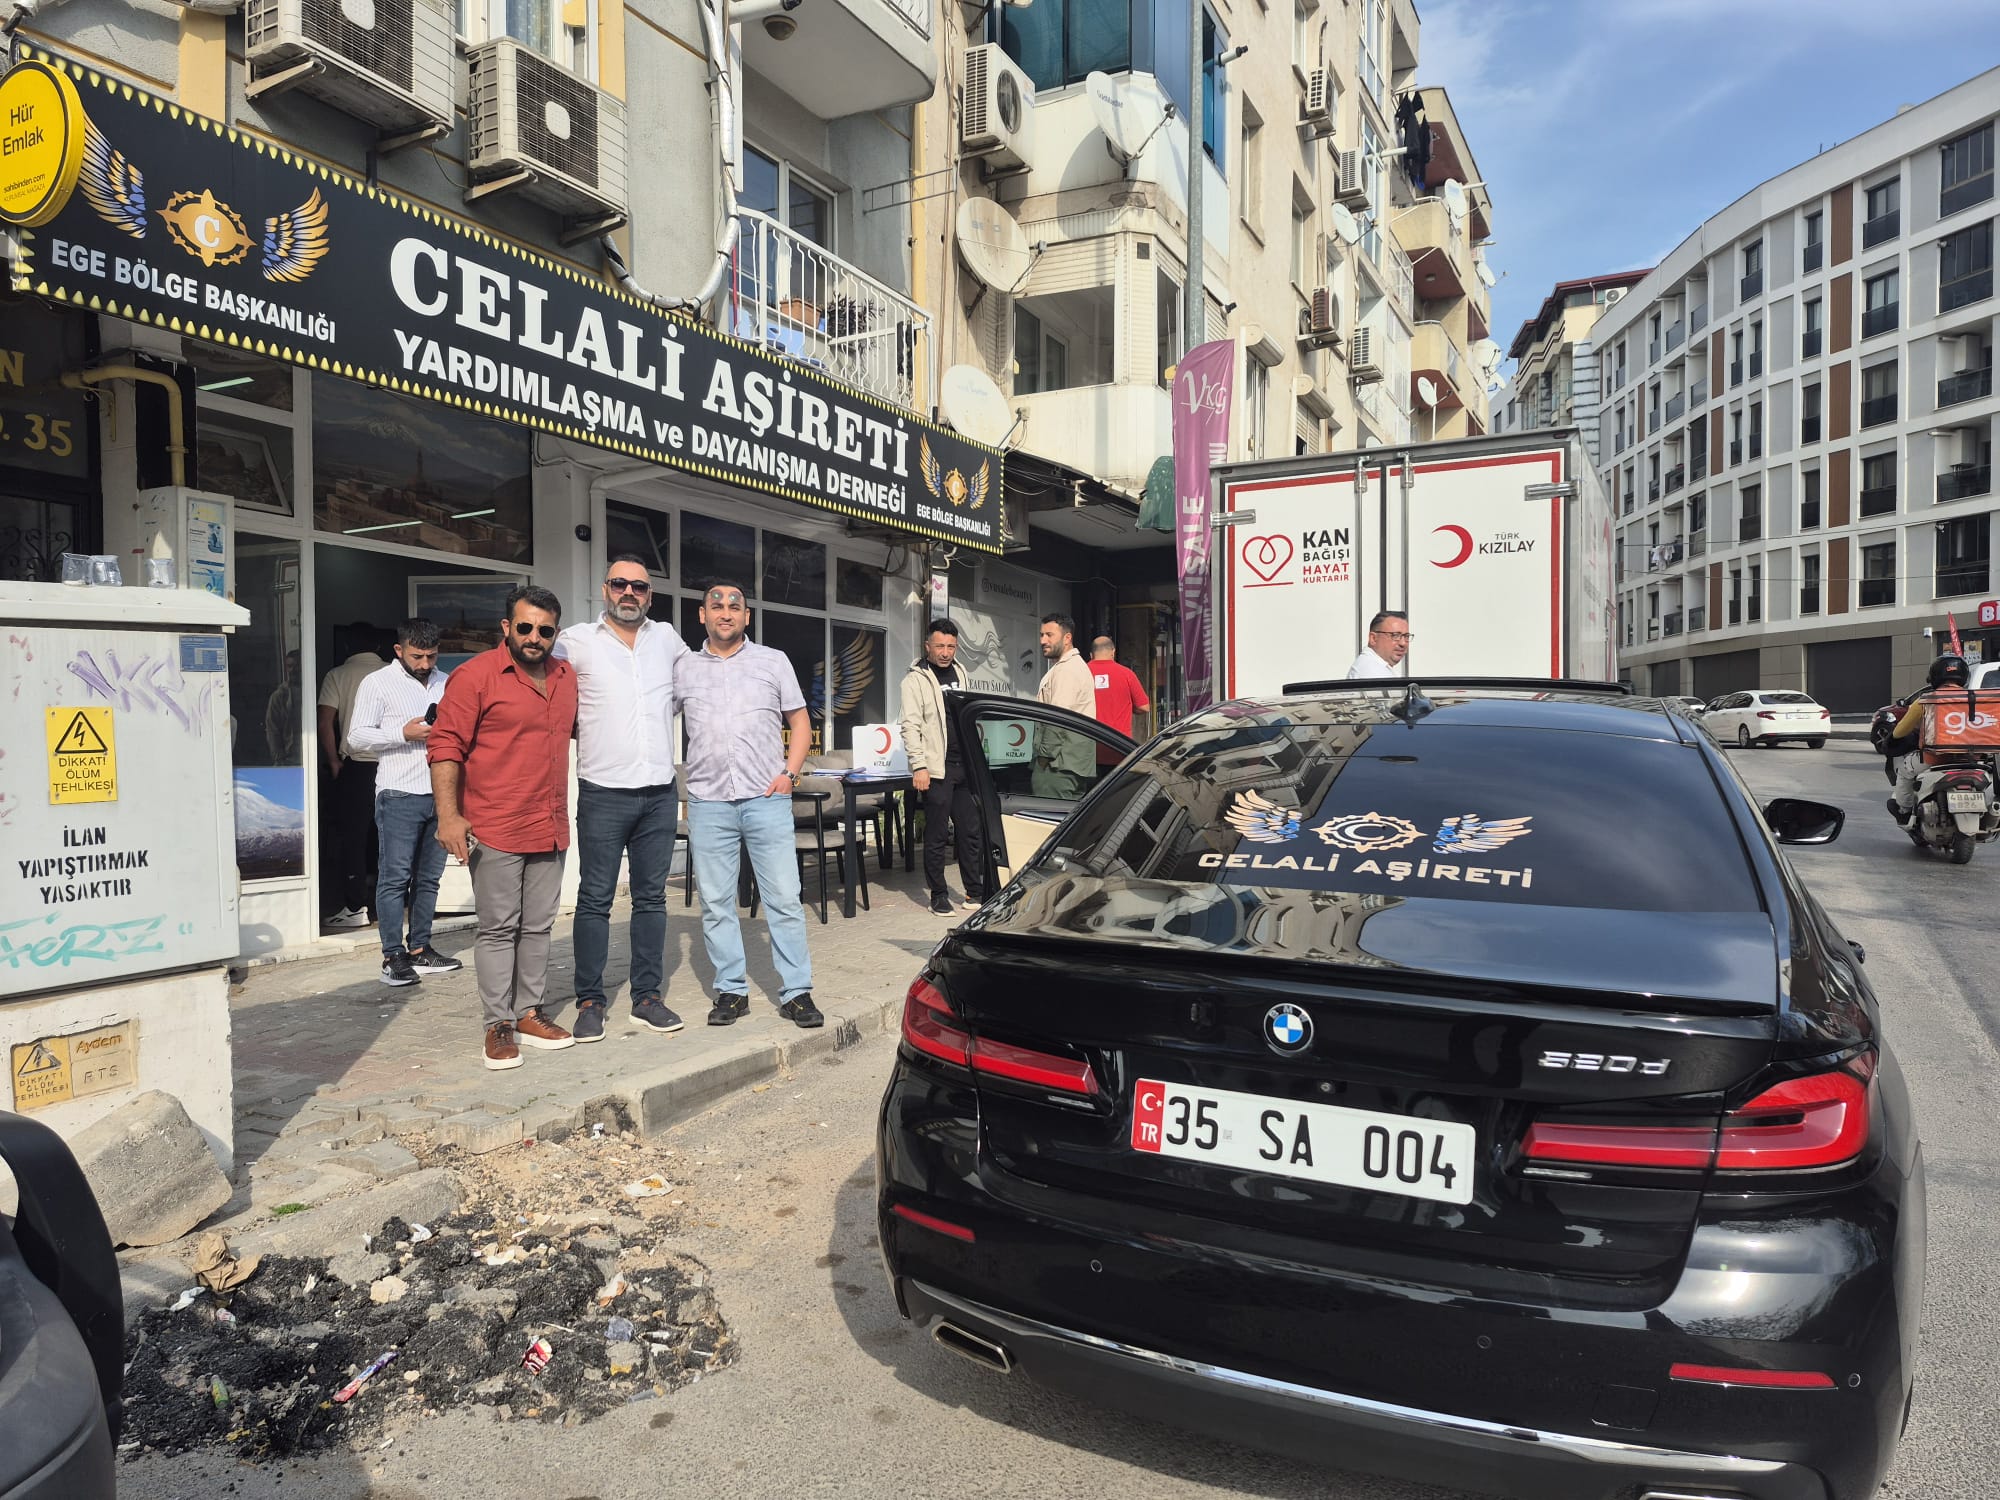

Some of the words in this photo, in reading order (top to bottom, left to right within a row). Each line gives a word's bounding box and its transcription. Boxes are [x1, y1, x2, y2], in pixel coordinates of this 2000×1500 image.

[10, 103, 35, 127] Hür
[3, 126, 44, 156] Emlak
[4, 173, 46, 193] sahibinden.com
[52, 238, 106, 279] EGE
[114, 258, 198, 304] BÖLGE
[205, 283, 336, 344] BAŞKANLIĞI
[390, 237, 685, 401] CELALİ
[702, 358, 909, 478] AŞİRETİ
[393, 329, 646, 439] YARDIMLAŞMA
[653, 419, 684, 449] ve
[692, 424, 821, 490] DAYANIŞMA
[826, 468, 906, 515] DERNEĞİ
[916, 503, 931, 520] EGE
[932, 506, 953, 527] BÖLGE
[954, 514, 991, 537] BAŞKANLIĞI
[1303, 527, 1349, 549] KAN
[1479, 540, 1535, 554] KIZILAY
[1495, 531, 1520, 540] TÜRK
[1303, 547, 1349, 562] BAĞIŞI
[1303, 562, 1349, 575] HAYAT
[1303, 574, 1349, 584] KURTARIR
[65, 768, 101, 779] ÖLÜM
[53, 779, 114, 792] TEHLİKESİ
[63, 825, 106, 847] İLAN
[18, 850, 149, 880] YAPIŞTIRMAK
[1198, 853, 1341, 873] CELALİ
[1352, 858, 1534, 889] AŞİRETİ
[40, 879, 131, 905] YASAKTIR
[1140, 1121, 1158, 1144] TR
[1166, 1095, 1219, 1151] 35
[1259, 1110, 1313, 1167] SA
[1363, 1124, 1457, 1189] 004
